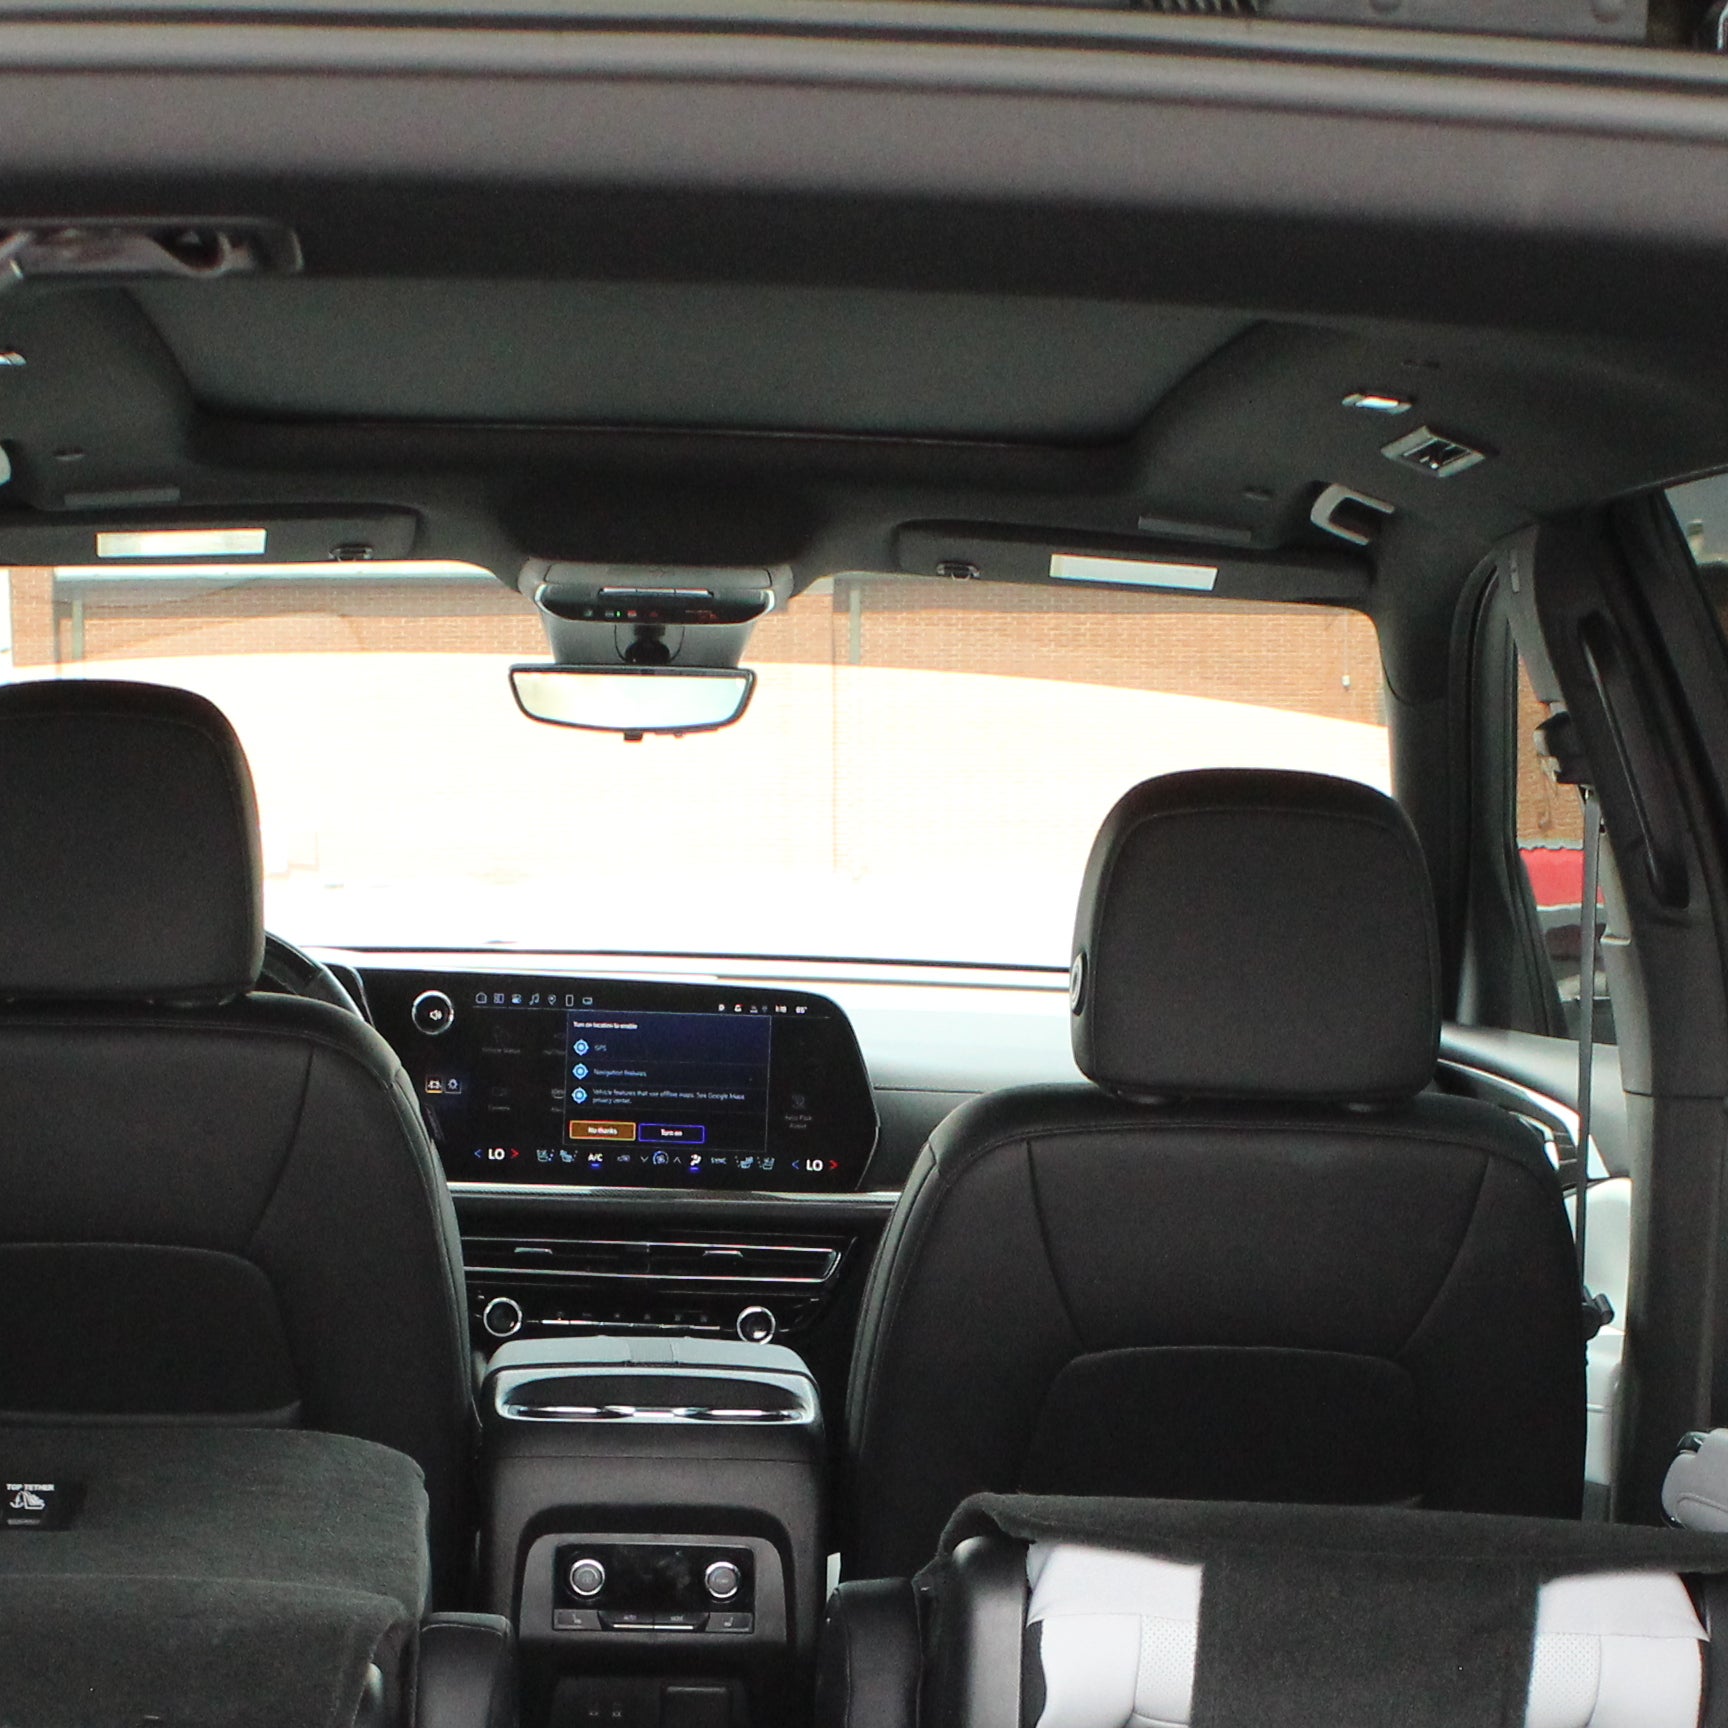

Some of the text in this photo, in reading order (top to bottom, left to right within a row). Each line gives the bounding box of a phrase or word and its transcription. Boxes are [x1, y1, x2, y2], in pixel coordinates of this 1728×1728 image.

[597, 1126, 618, 1135] thanks
[660, 1128, 674, 1136] Turn
[488, 1148, 505, 1160] LO
[587, 1153, 603, 1162] A/C
[806, 1159, 823, 1171] LO
[6, 1483, 23, 1491] TOP
